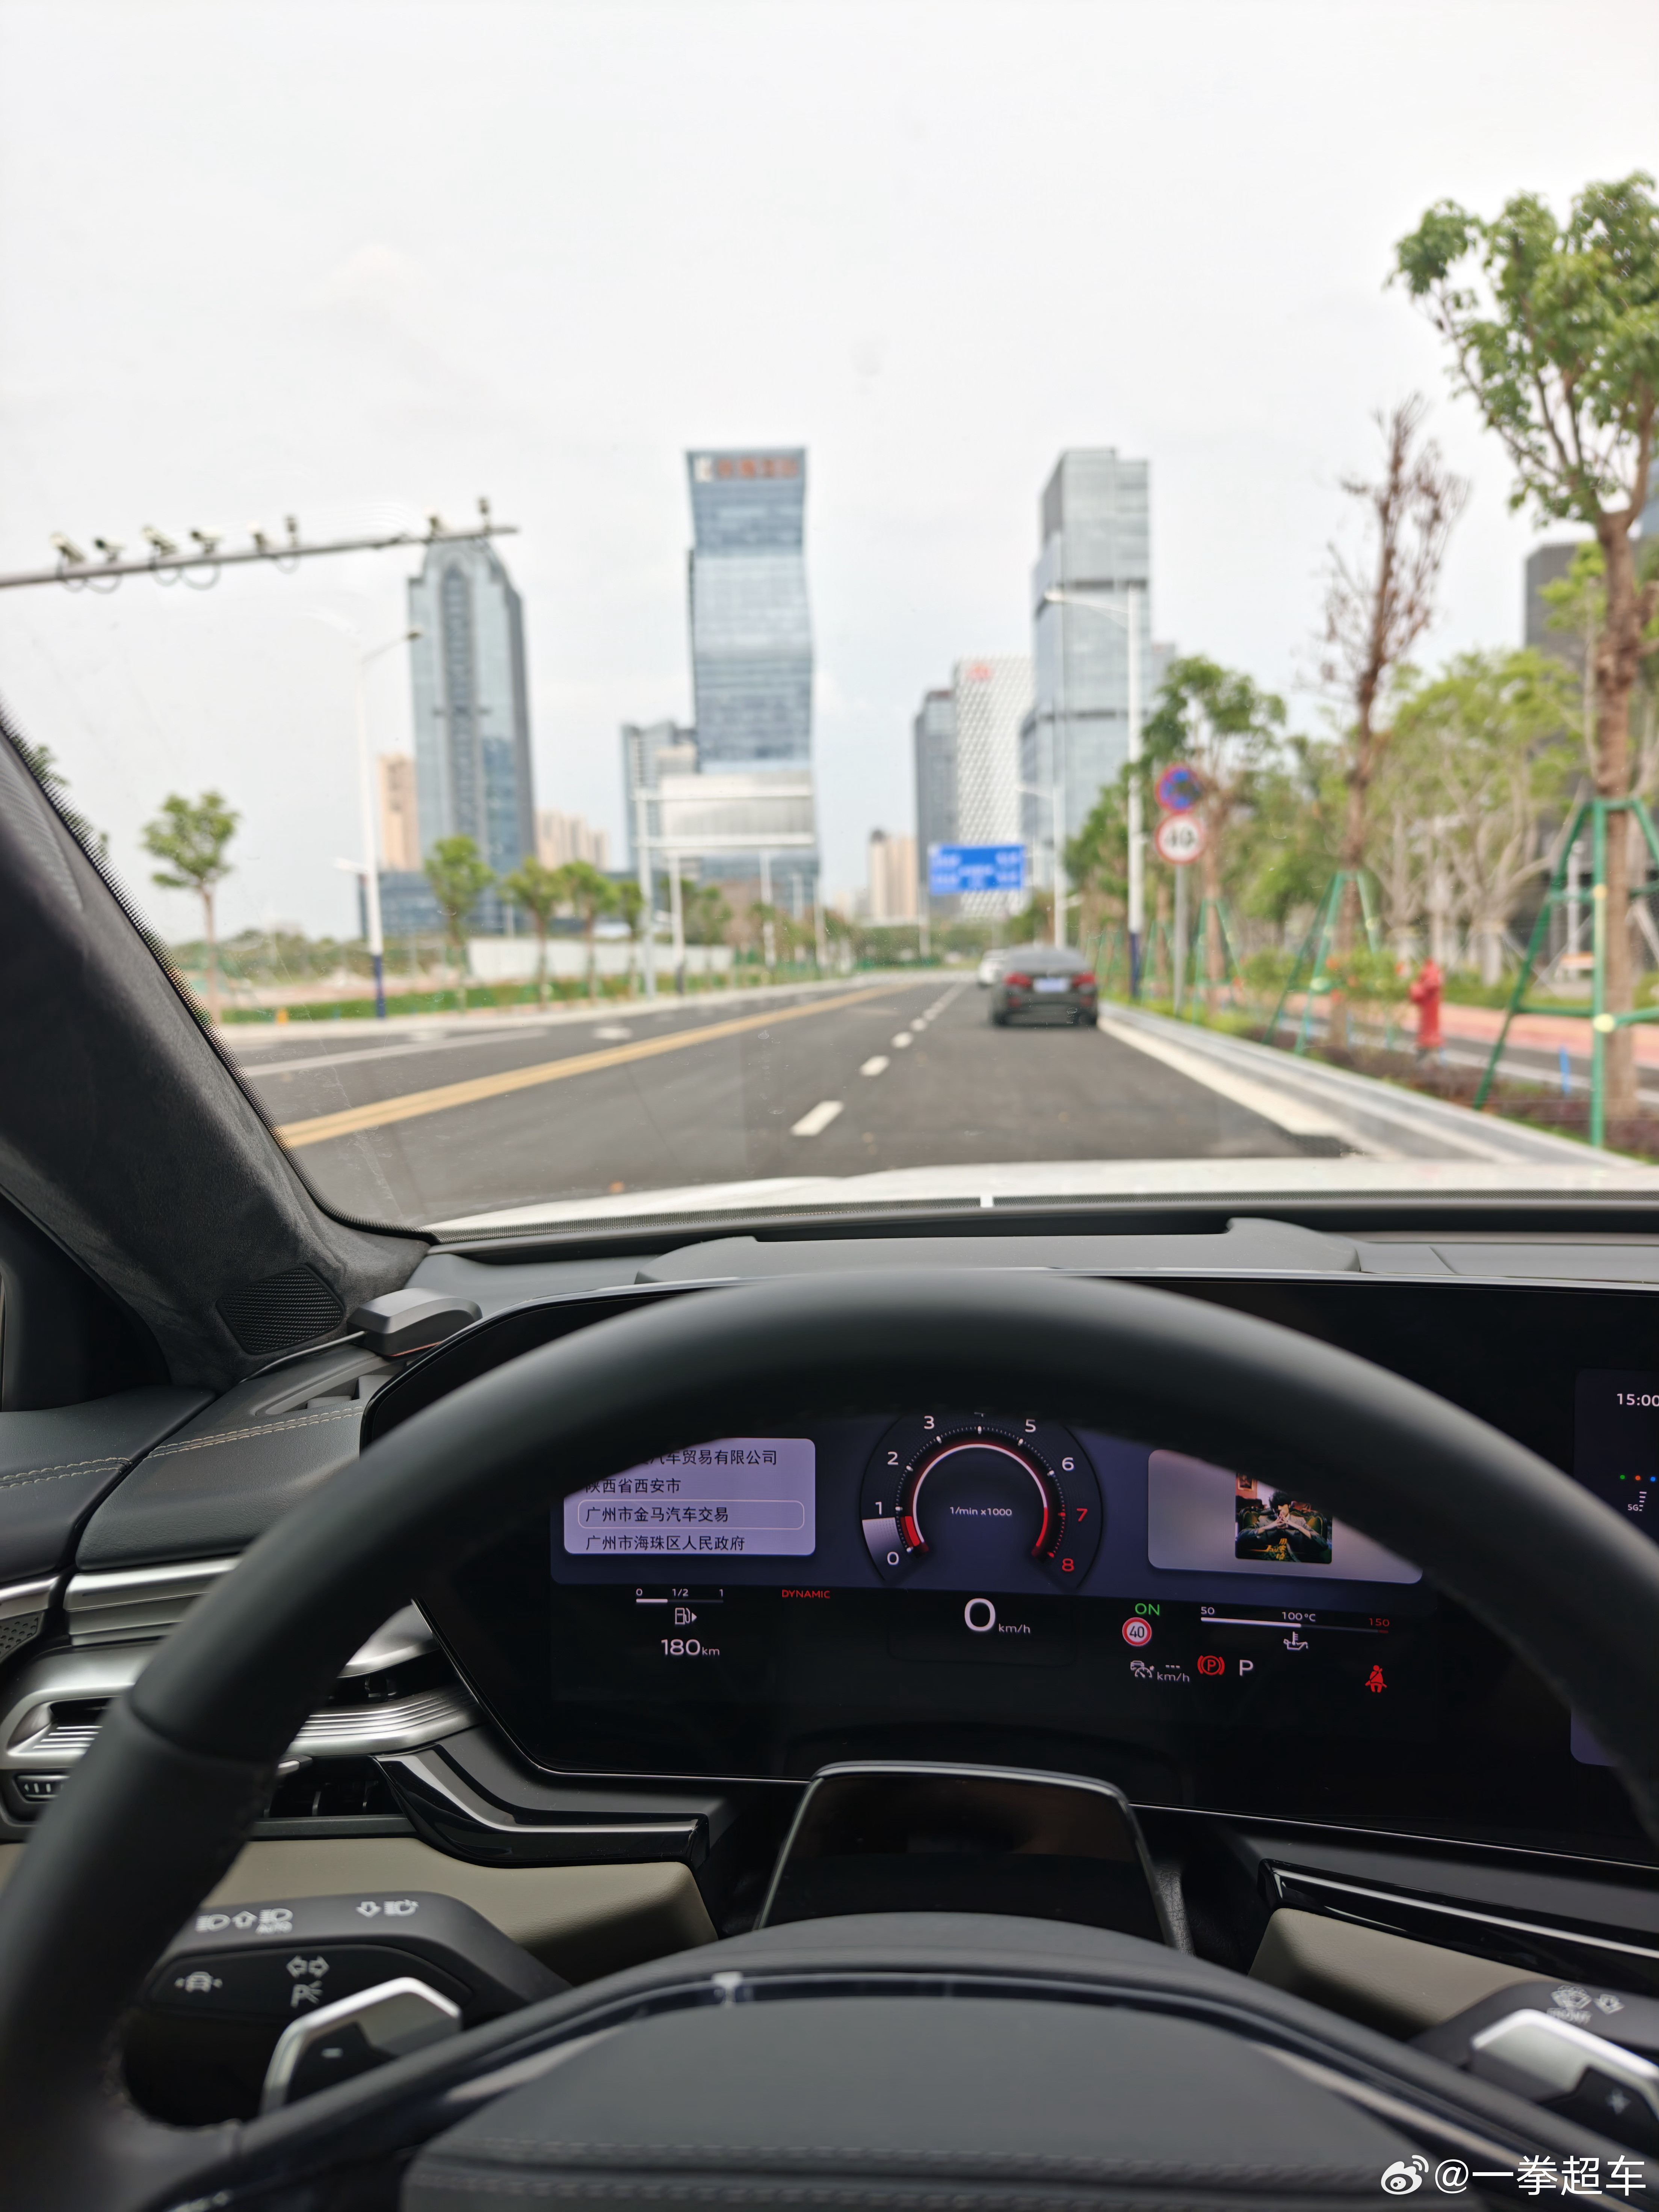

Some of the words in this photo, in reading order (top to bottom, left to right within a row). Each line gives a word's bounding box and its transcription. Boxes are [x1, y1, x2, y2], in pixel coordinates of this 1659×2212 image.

[1617, 1393, 1659, 1407] 15:00
[924, 1416, 935, 1429] 3
[1025, 1419, 1036, 1433] 5
[644, 1450, 777, 1465] 车贸易有限公司
[887, 1451, 899, 1465] 2
[1062, 1457, 1074, 1471] 6
[585, 1478, 681, 1494] 陕西省西安市
[586, 1506, 728, 1523] 广州市金马汽车交易
[875, 1502, 882, 1515] 1
[950, 1506, 978, 1516] 1/min
[980, 1507, 1012, 1517] x1000
[1076, 1508, 1088, 1522] 7
[586, 1535, 745, 1551] 广州市海珠区人民政府
[887, 1551, 899, 1566] 0
[1062, 1558, 1074, 1572] 8
[672, 1588, 689, 1597] 1/2
[781, 1589, 831, 1599] DYNAMIC
[1135, 1603, 1160, 1616] ON
[1201, 1606, 1215, 1615] 50
[1369, 1617, 1390, 1627] 150
[1129, 1625, 1145, 1638] 40
[1239, 1659, 1254, 1677] P
[1157, 1671, 1190, 1683] km/h
